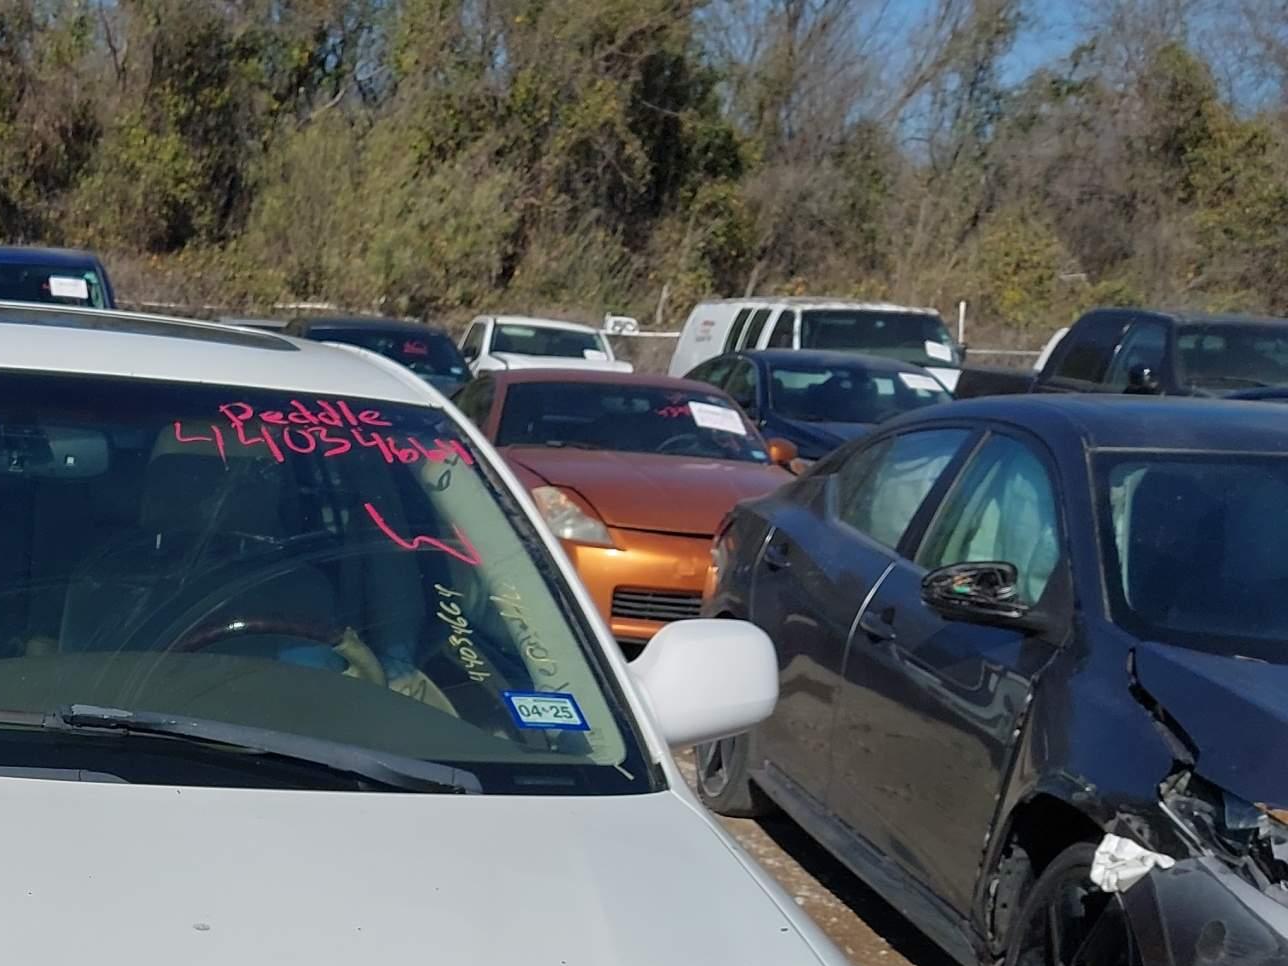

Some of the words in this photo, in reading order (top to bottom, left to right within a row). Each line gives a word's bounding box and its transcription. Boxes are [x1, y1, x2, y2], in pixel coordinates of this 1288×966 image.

[218, 399, 393, 429] Peddle
[434, 583, 492, 682] 44034664
[518, 704, 542, 718] 04
[550, 705, 574, 719] 25
